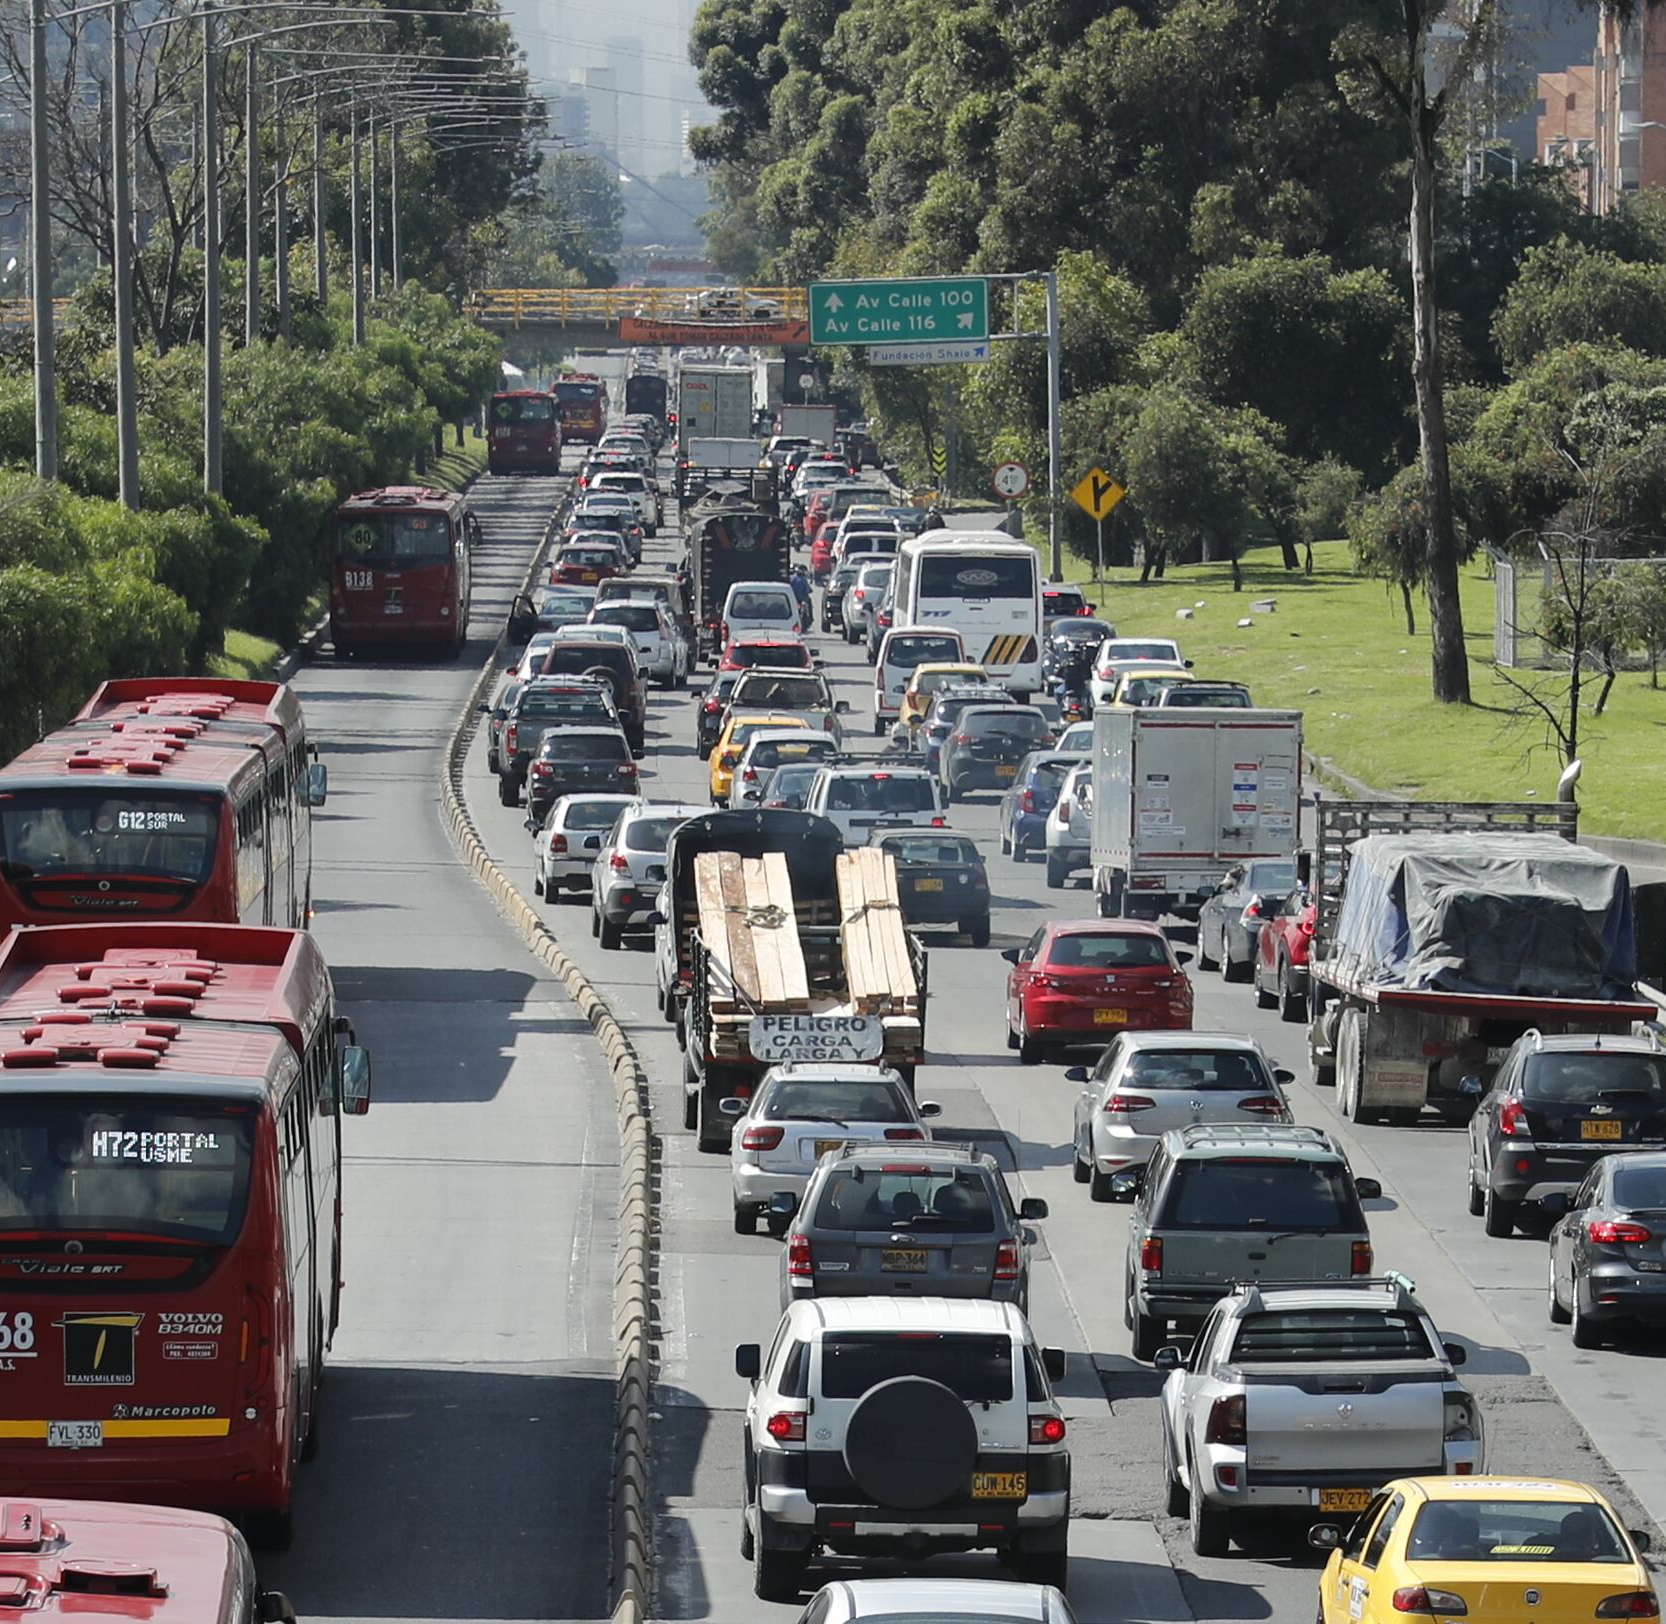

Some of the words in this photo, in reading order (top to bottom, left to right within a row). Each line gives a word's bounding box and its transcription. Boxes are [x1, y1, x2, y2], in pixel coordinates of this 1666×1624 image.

[856, 294, 880, 310] Av
[888, 293, 933, 308] Calle
[940, 290, 974, 307] 100
[825, 318, 850, 333] Av
[857, 317, 902, 332] Calle
[908, 314, 936, 331] 116
[118, 811, 146, 830] G12
[146, 811, 186, 822] PORTAL
[146, 821, 169, 830] SUR
[771, 1035, 853, 1048] CARGA
[765, 1047, 850, 1060] LARGA
[850, 1047, 865, 1060] Y
[92, 1130, 139, 1159] H72
[139, 1131, 220, 1149] PORTAL
[140, 1148, 193, 1163] USME
[19, 1261, 86, 1275] Viale
[157, 1313, 223, 1323] VOLVO
[156, 1323, 223, 1335] B340M
[66, 1374, 132, 1383] TRANSMILENIO
[131, 1404, 217, 1418] Marcopolo
